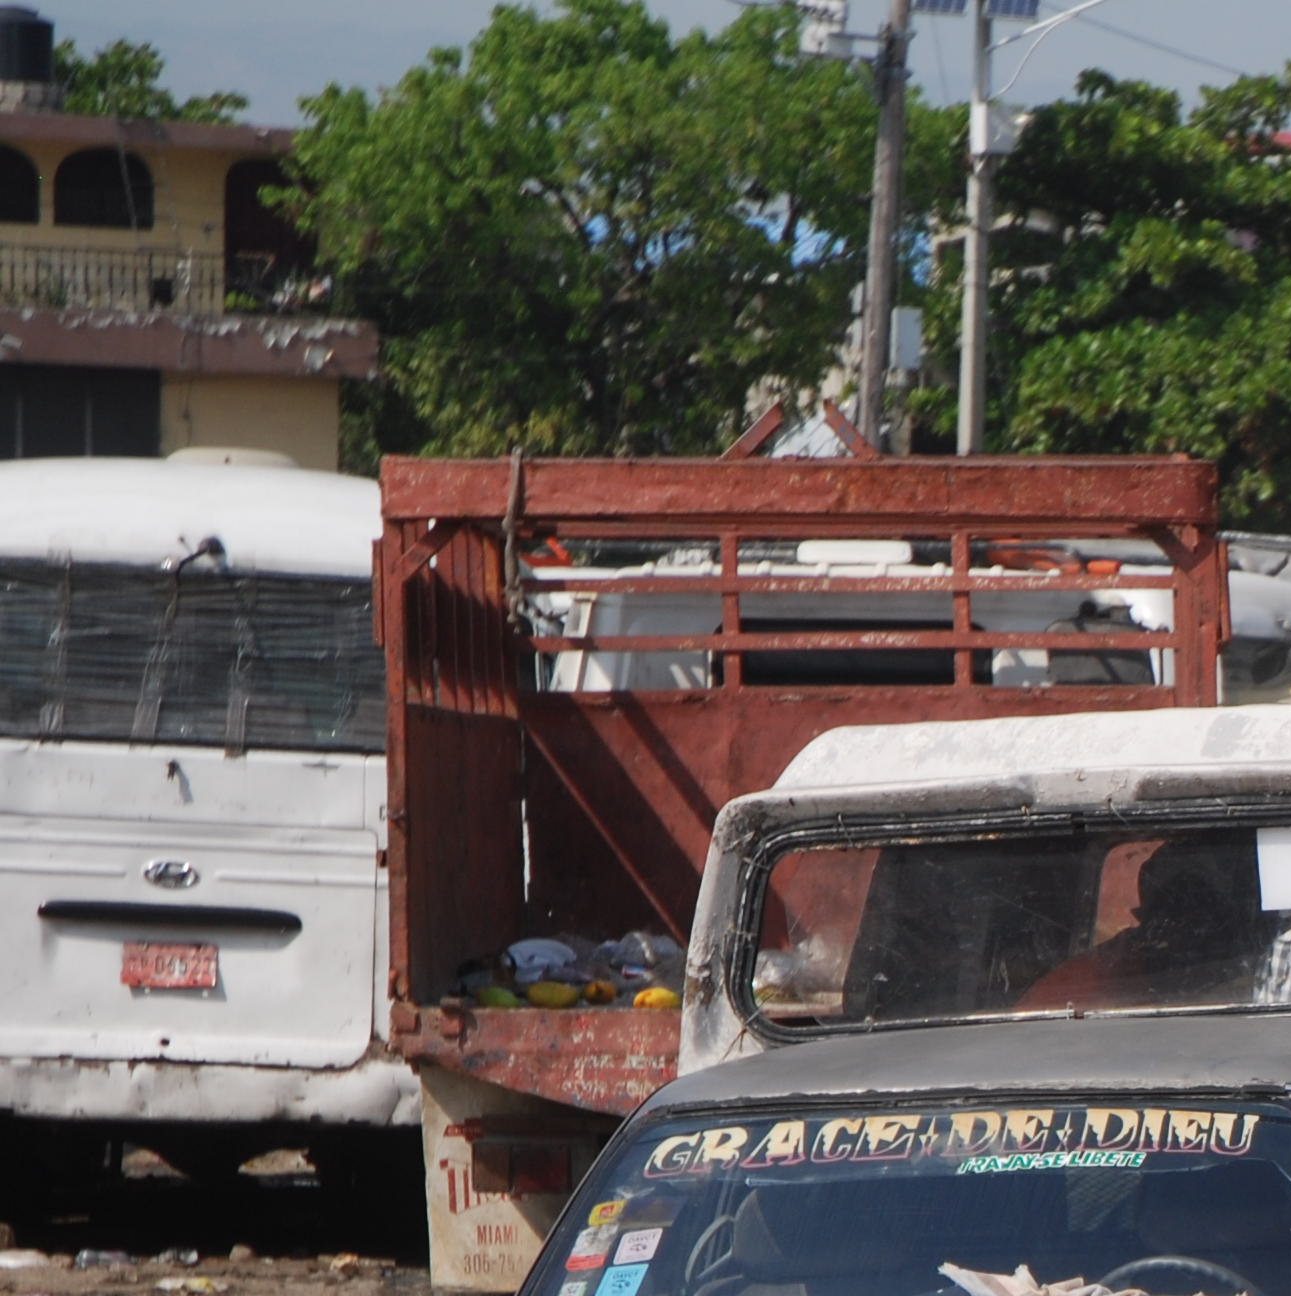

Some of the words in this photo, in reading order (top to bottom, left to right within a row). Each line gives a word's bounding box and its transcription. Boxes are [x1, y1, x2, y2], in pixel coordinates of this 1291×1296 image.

[643, 1114, 922, 1179] GRACE
[947, 1108, 1055, 1157] DE
[1076, 1107, 1260, 1156] DIEU
